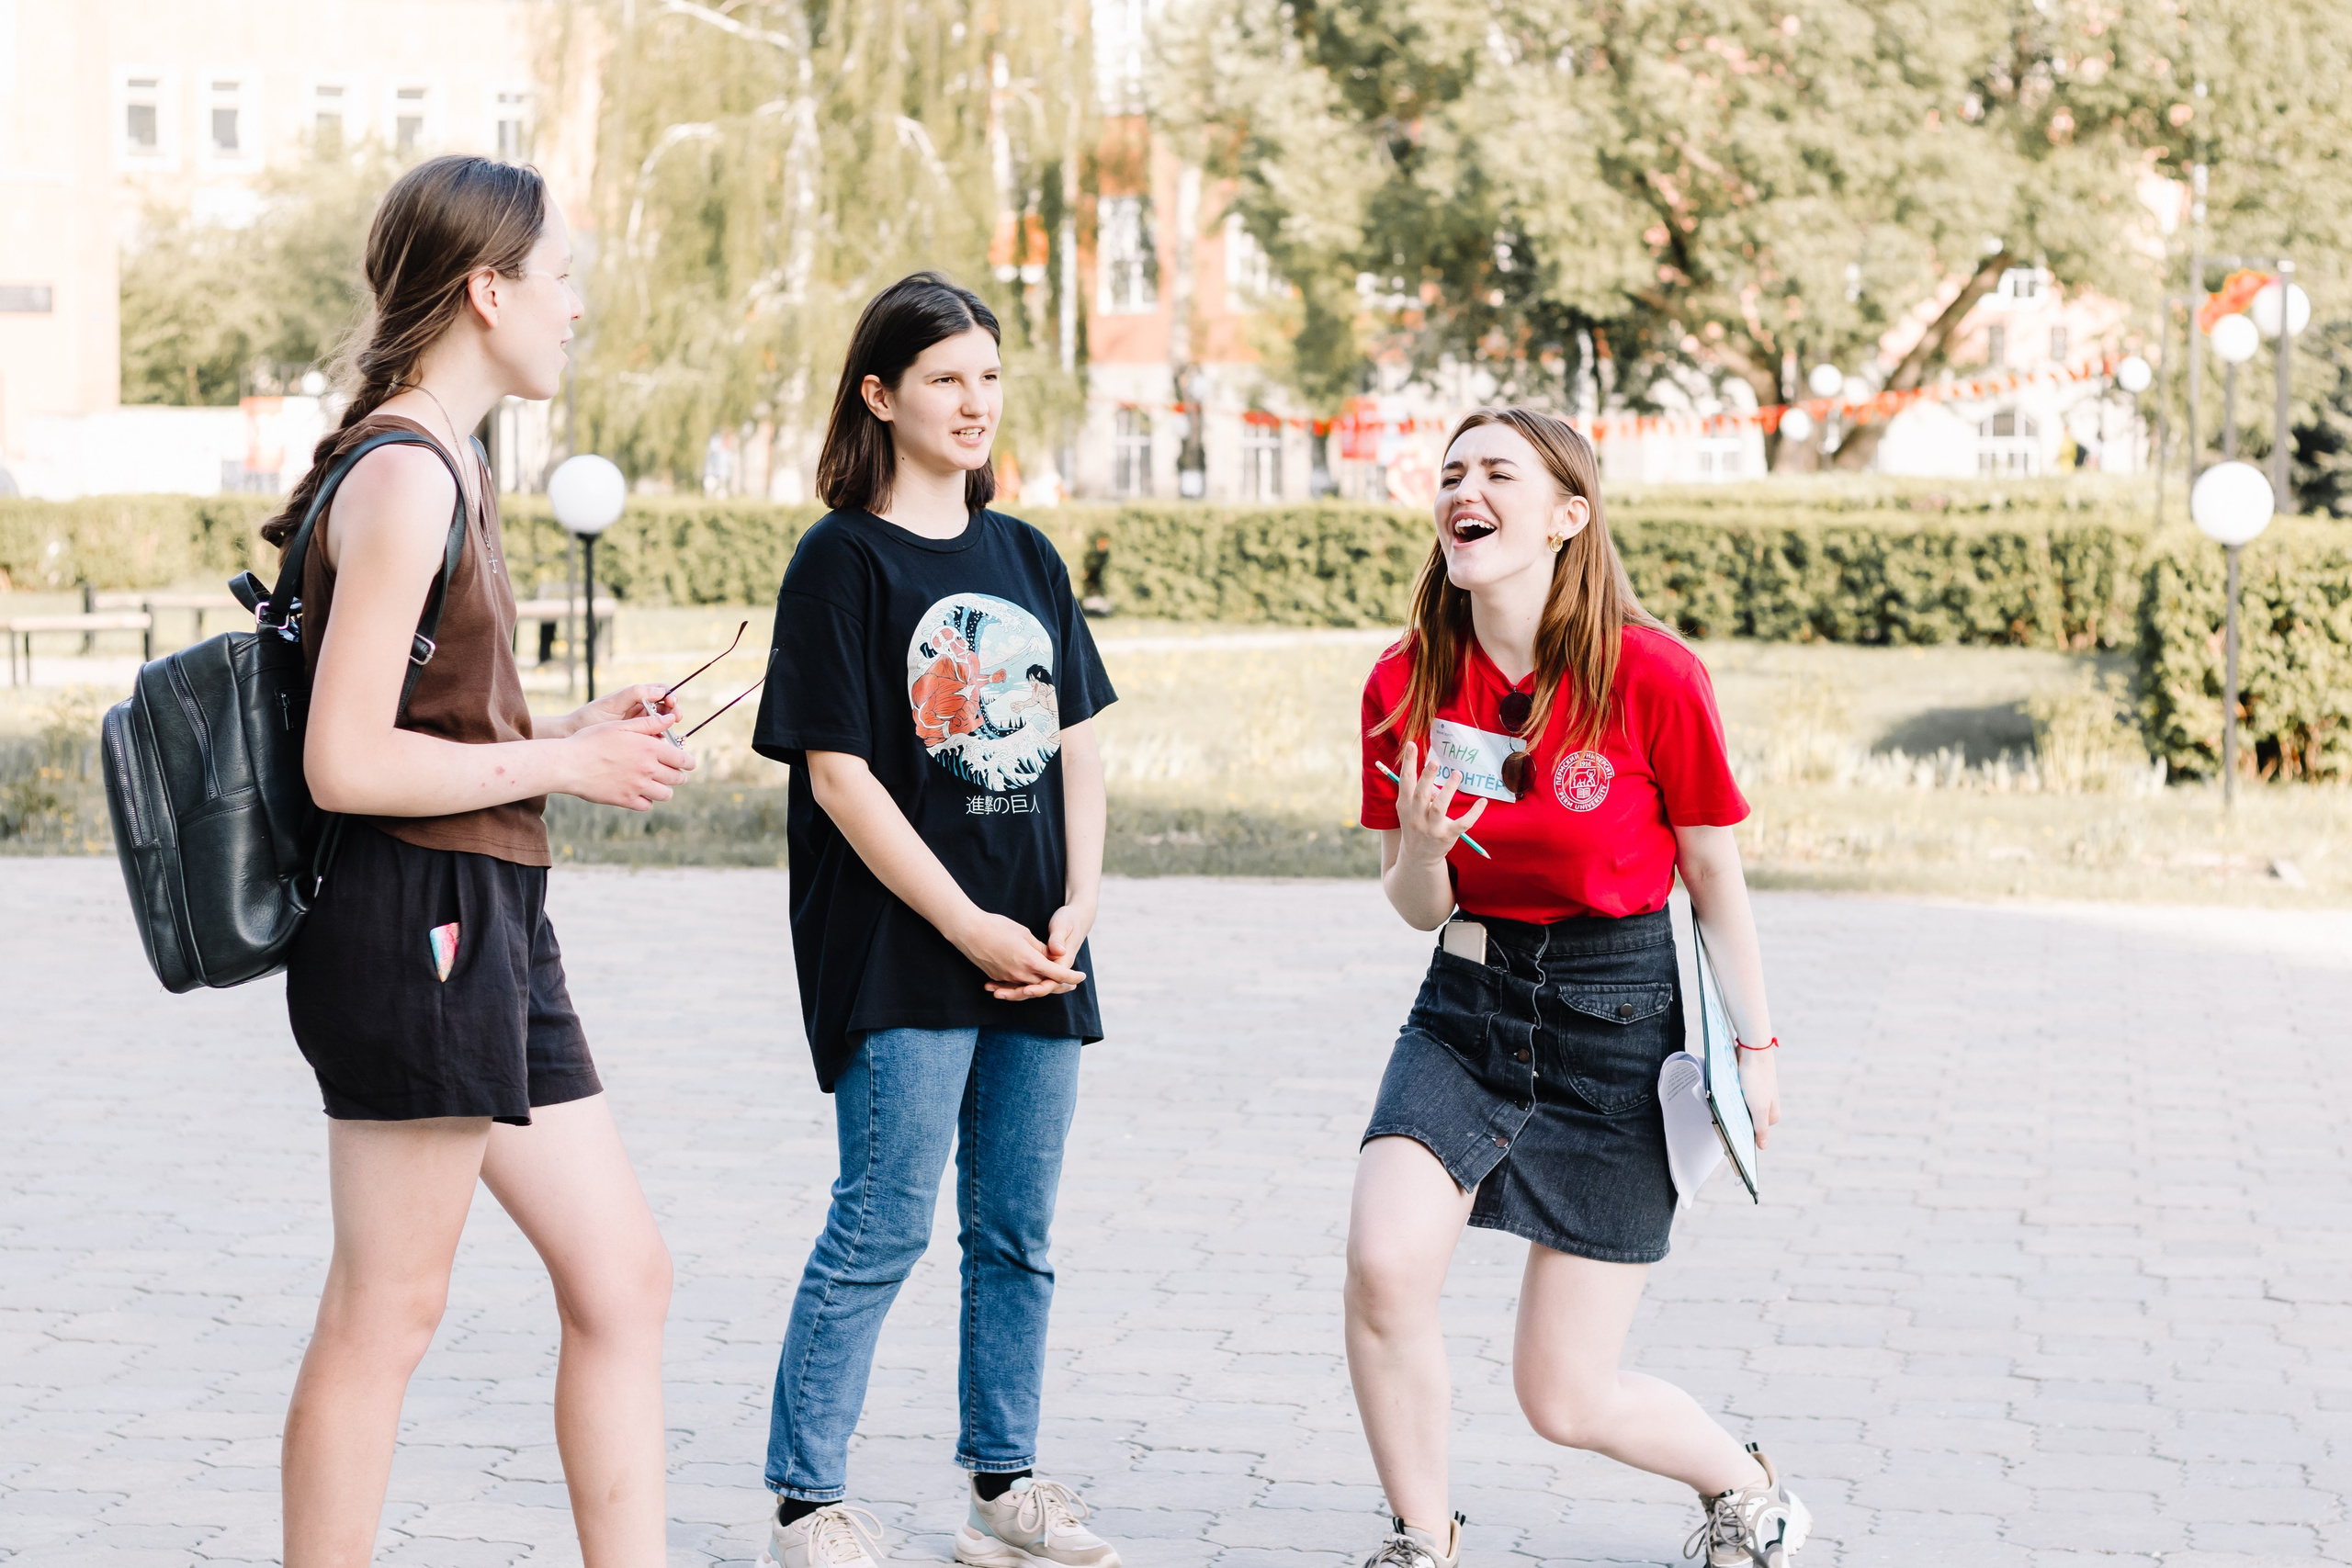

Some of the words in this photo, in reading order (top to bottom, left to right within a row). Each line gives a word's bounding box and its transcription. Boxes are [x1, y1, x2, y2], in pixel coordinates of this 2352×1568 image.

[1442, 740, 1480, 764] ТАНЯ
[1436, 765, 1506, 791] ОНТЁР
[966, 794, 1041, 816] 進撃の巨人
[1558, 791, 1574, 807] PERM
[1574, 784, 1607, 810] UNIVERSITY
